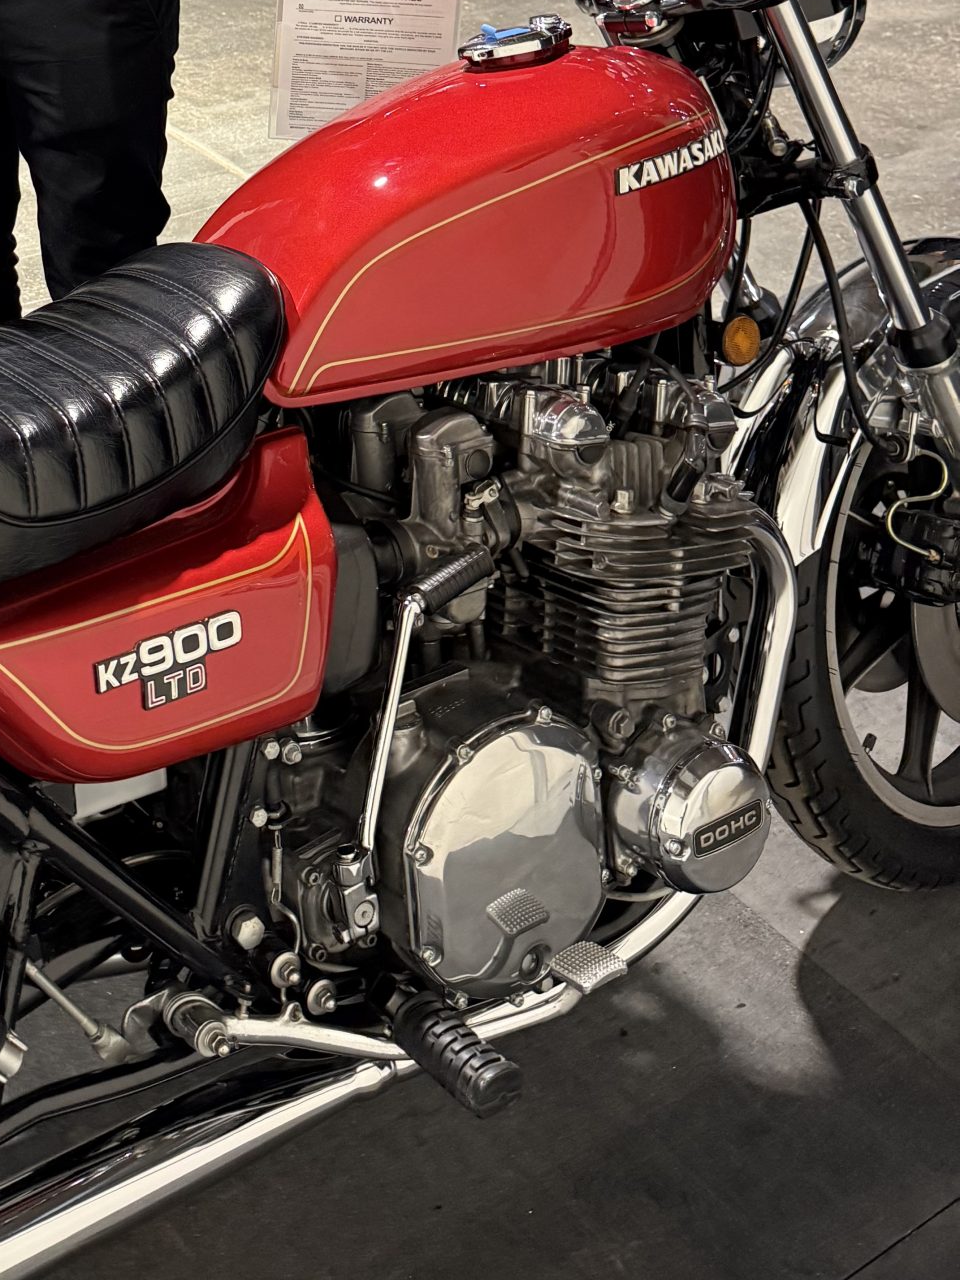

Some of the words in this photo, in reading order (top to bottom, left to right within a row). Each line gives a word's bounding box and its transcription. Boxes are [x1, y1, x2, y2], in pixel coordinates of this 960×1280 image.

[344, 15, 394, 25] WARRANTY
[618, 128, 725, 195] KAWASAKI
[97, 610, 243, 694] KZ900
[147, 663, 206, 708] LTD
[699, 809, 757, 849] DOHC
